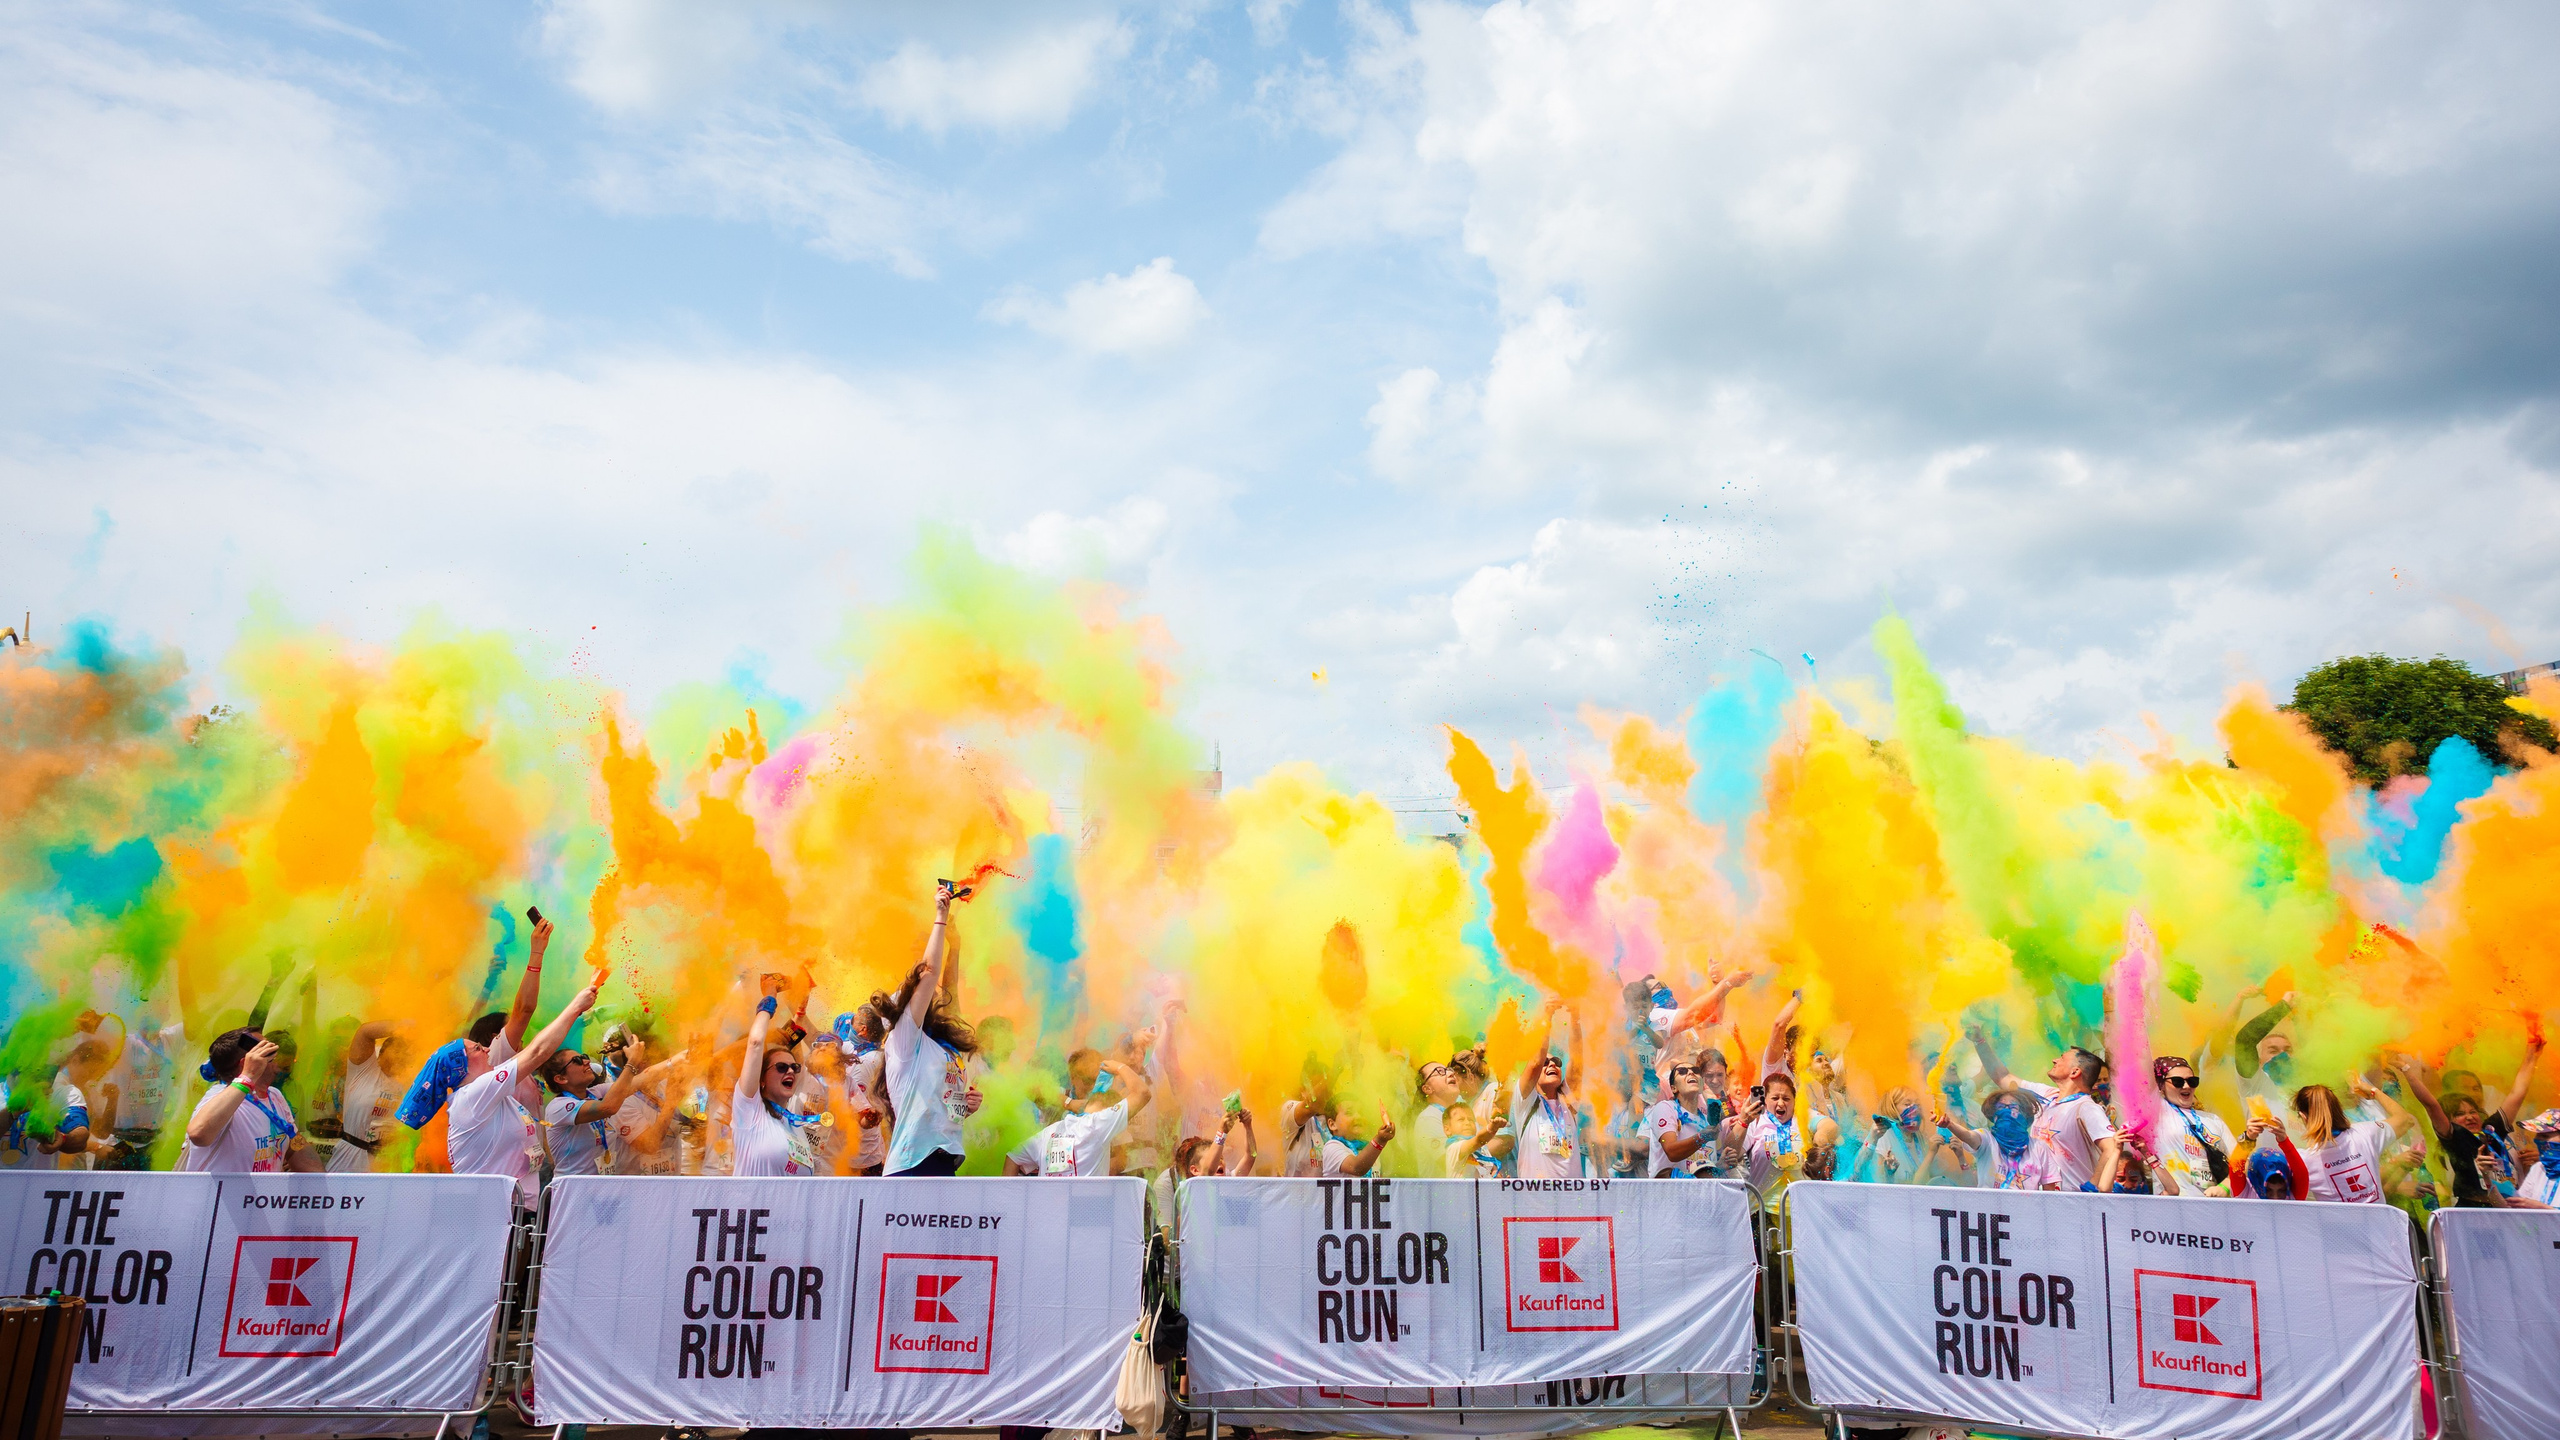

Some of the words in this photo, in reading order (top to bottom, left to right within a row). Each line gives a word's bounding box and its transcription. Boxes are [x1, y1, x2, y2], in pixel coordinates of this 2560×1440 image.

[255, 1135, 269, 1149] THE
[2184, 1144, 2200, 1157] RUN
[252, 1160, 268, 1172] RUN
[785, 1161, 799, 1175] RUN
[1501, 1179, 1585, 1192] POWERED
[1590, 1179, 1611, 1192] BY
[243, 1195, 334, 1209] POWERED
[340, 1196, 365, 1210] BY
[1316, 1178, 1391, 1230] THE
[44, 1190, 125, 1245] THE
[885, 1213, 973, 1228] POWERED
[978, 1216, 1002, 1230] BY
[692, 1208, 770, 1262] THE
[1931, 1208, 2012, 1267] THE
[2131, 1228, 2223, 1250] POWERED
[2230, 1238, 2254, 1253] BY
[1317, 1232, 1450, 1286] COLOR
[25, 1248, 173, 1305] COLOR
[683, 1265, 824, 1320] COLOR
[1518, 1294, 1605, 1311] Kaufland
[1933, 1264, 2076, 1330] COLOR
[236, 1317, 331, 1336] Kaufland
[1318, 1289, 1398, 1343] RUN
[678, 1323, 765, 1379] RUN
[889, 1333, 978, 1353] Kaufland
[1935, 1320, 2021, 1382] RUN
[2152, 1350, 2248, 1377] Kaufland
